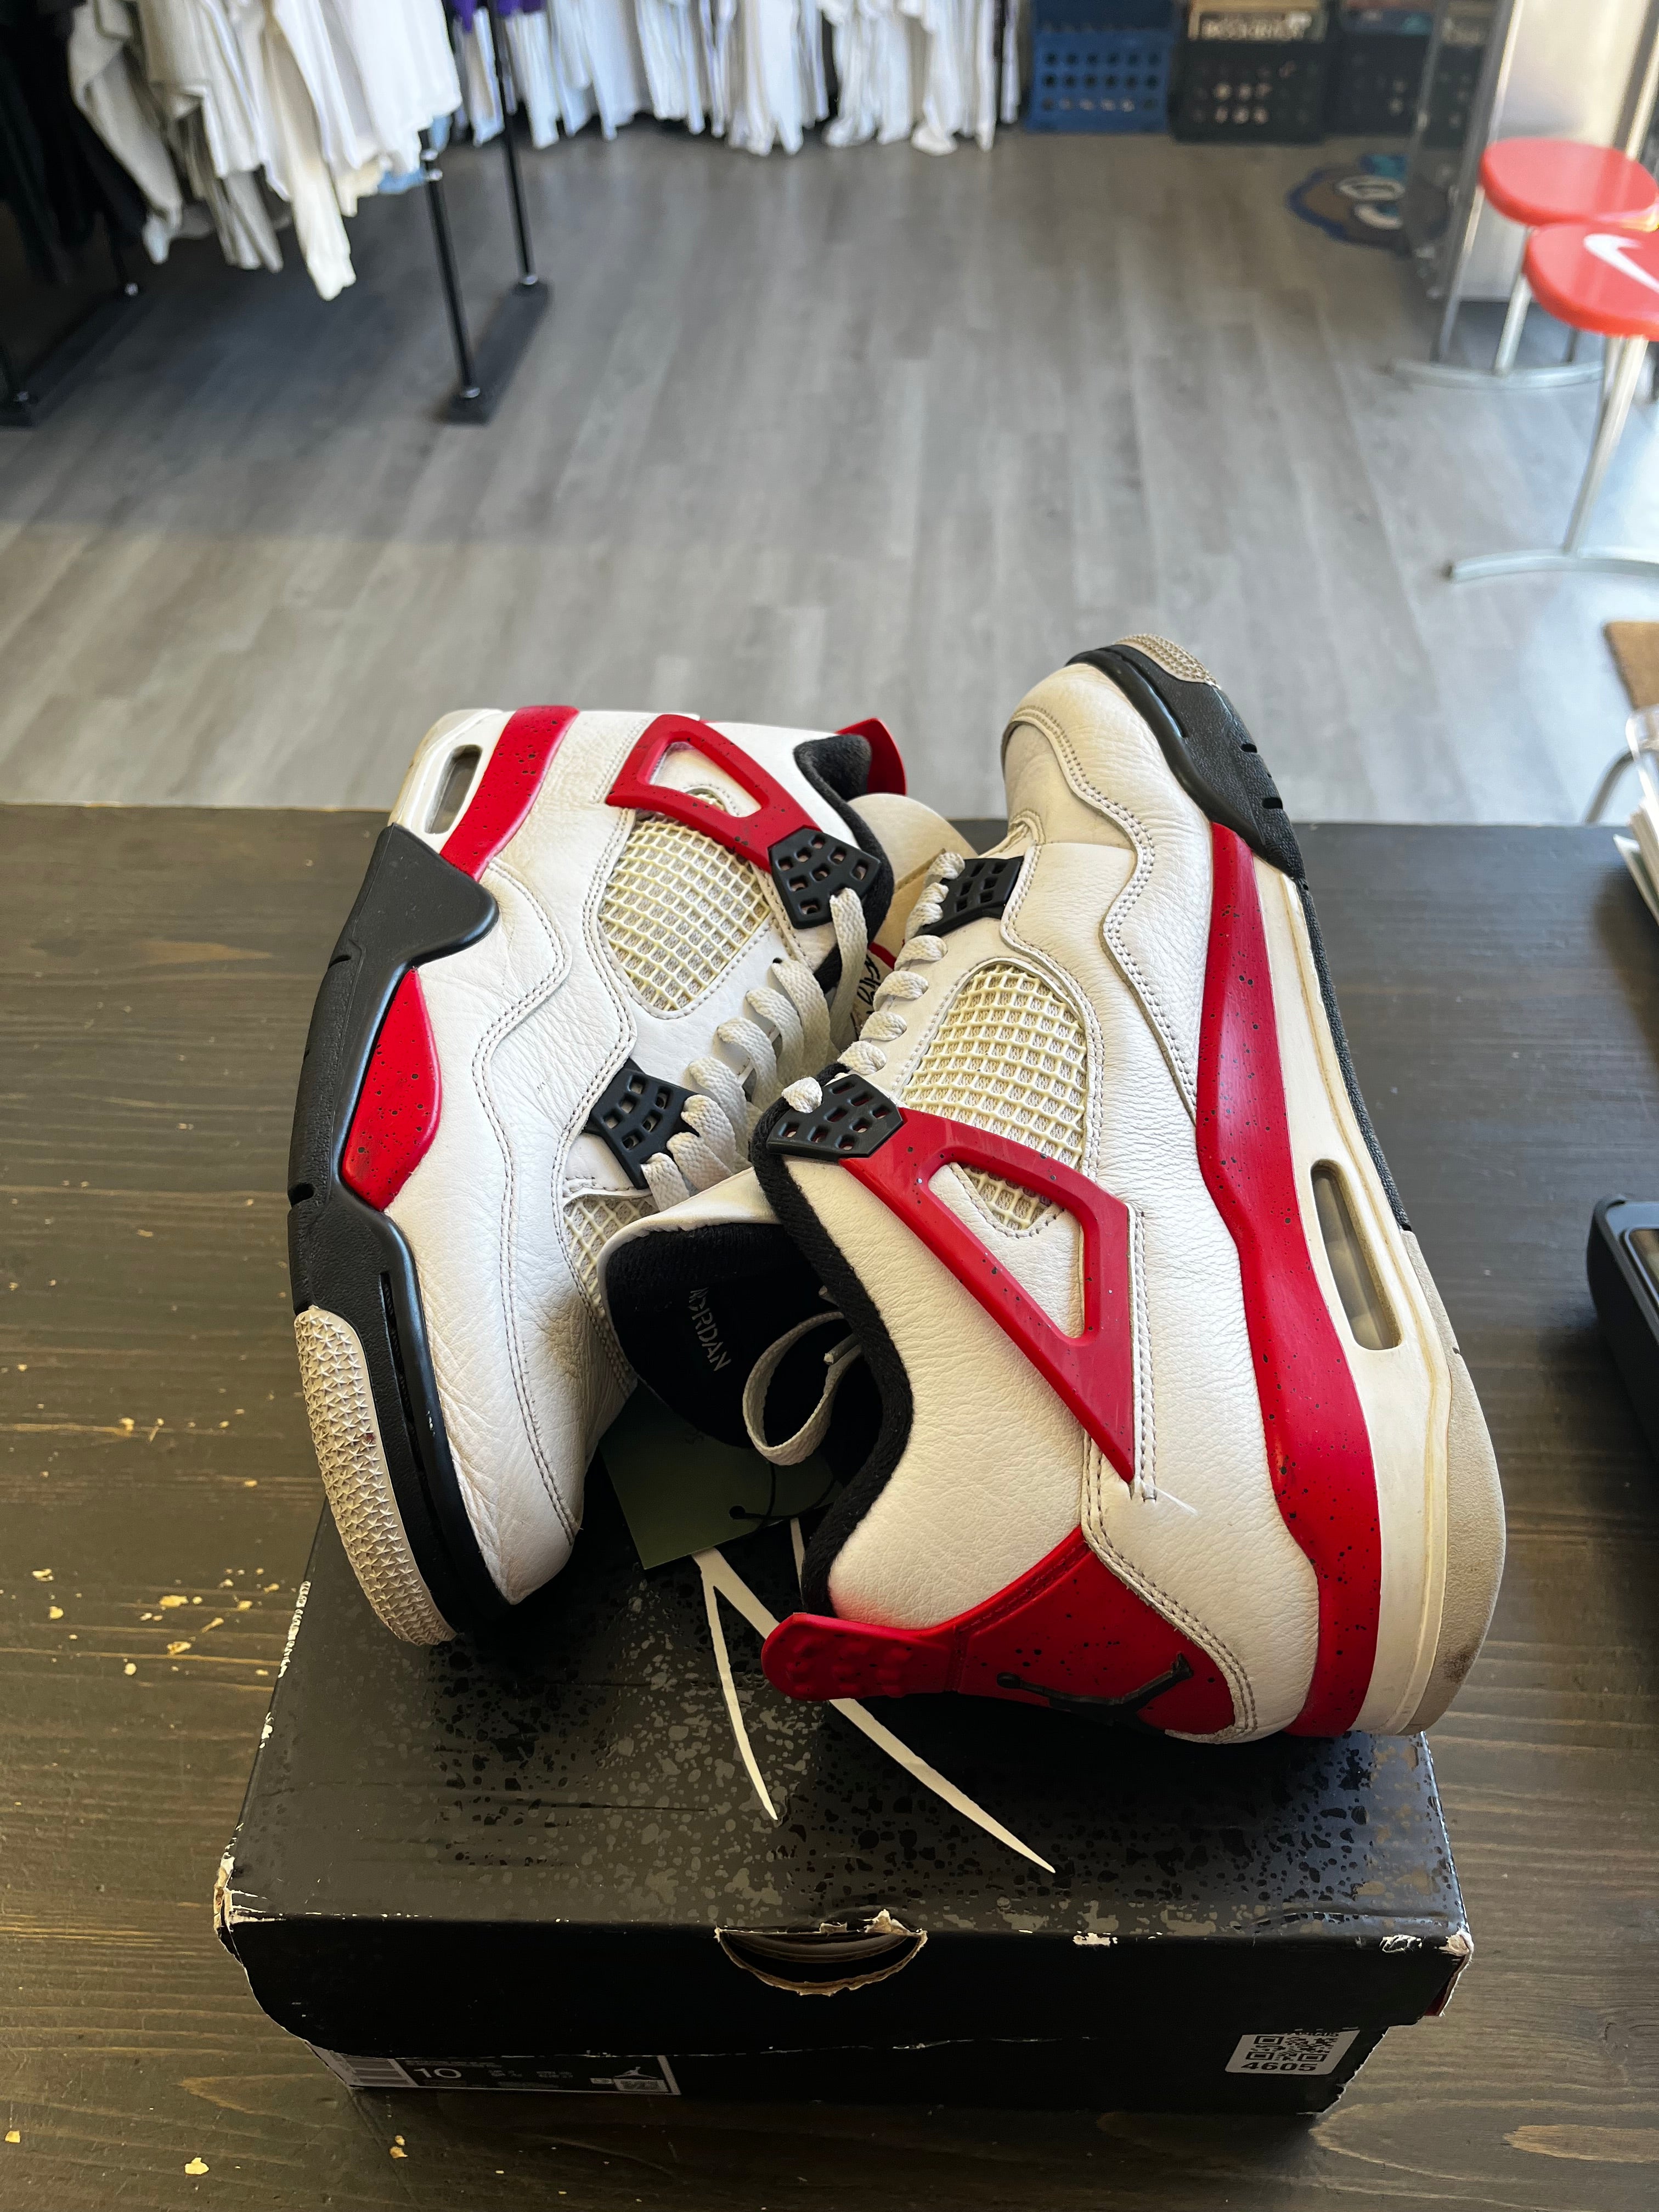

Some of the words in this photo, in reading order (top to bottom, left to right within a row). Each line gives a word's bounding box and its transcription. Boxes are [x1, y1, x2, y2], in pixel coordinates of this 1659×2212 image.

[689, 1287, 732, 1371] ORDAN
[1240, 2062, 1317, 2071] 4605
[414, 2068, 462, 2079] 10
